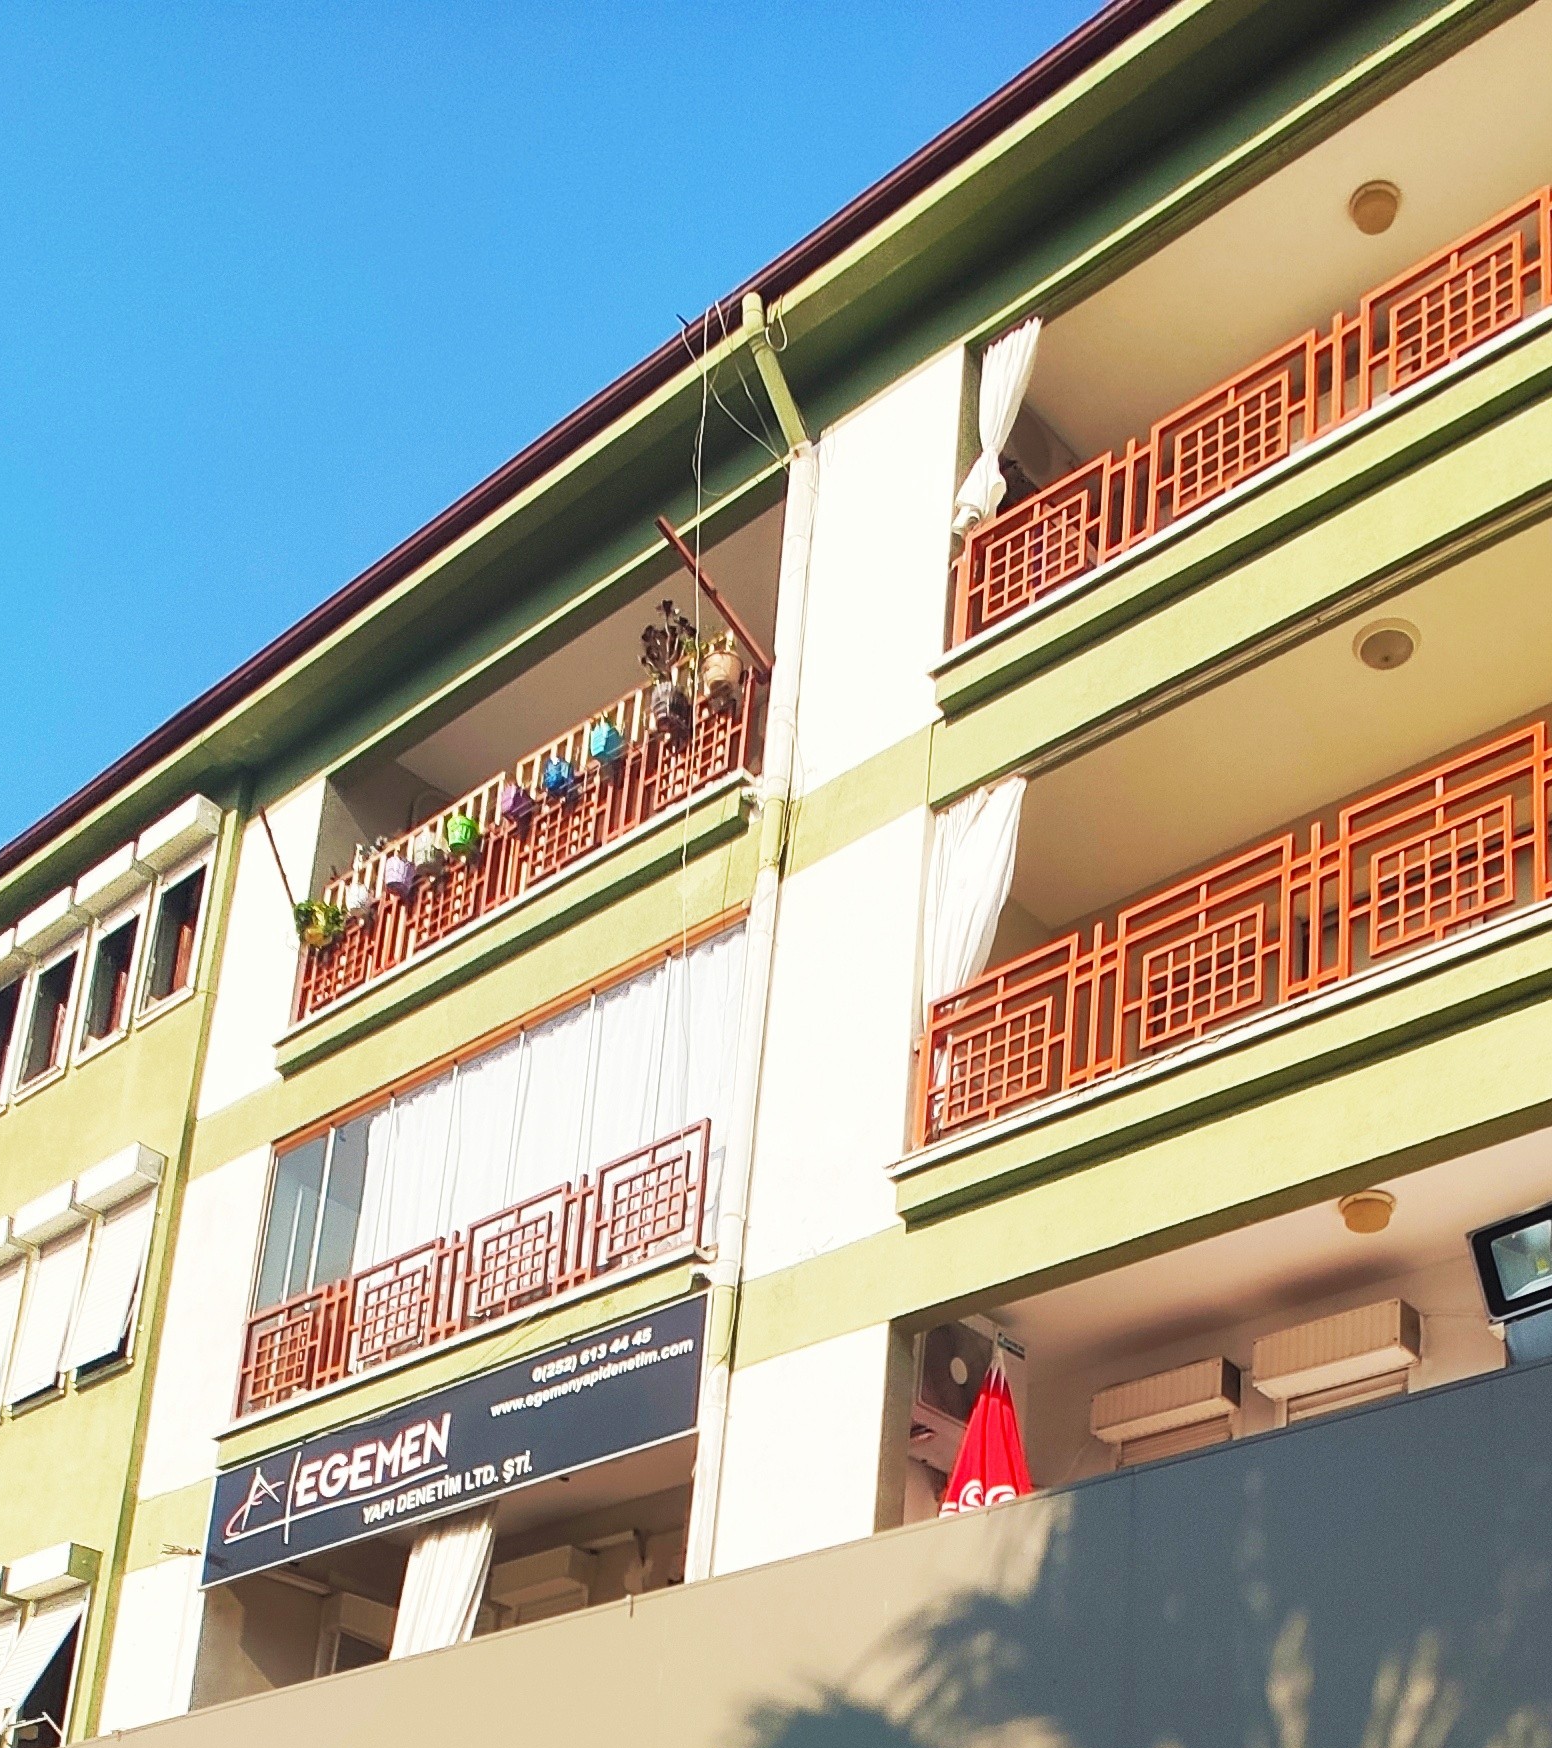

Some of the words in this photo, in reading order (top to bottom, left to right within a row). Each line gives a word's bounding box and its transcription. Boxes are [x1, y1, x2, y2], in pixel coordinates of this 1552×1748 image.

[490, 1338, 693, 1418] www.egemenyapidenetim.com
[532, 1353, 577, 1385] 0(252)
[580, 1344, 607, 1366] 613
[610, 1335, 630, 1355] 44
[632, 1326, 653, 1348] 45
[296, 1414, 451, 1508] EGEMEN
[363, 1503, 395, 1526] YAPI
[398, 1474, 462, 1516] DENETİM
[464, 1467, 499, 1497] LTD.
[504, 1449, 534, 1485] ŞTİ.
